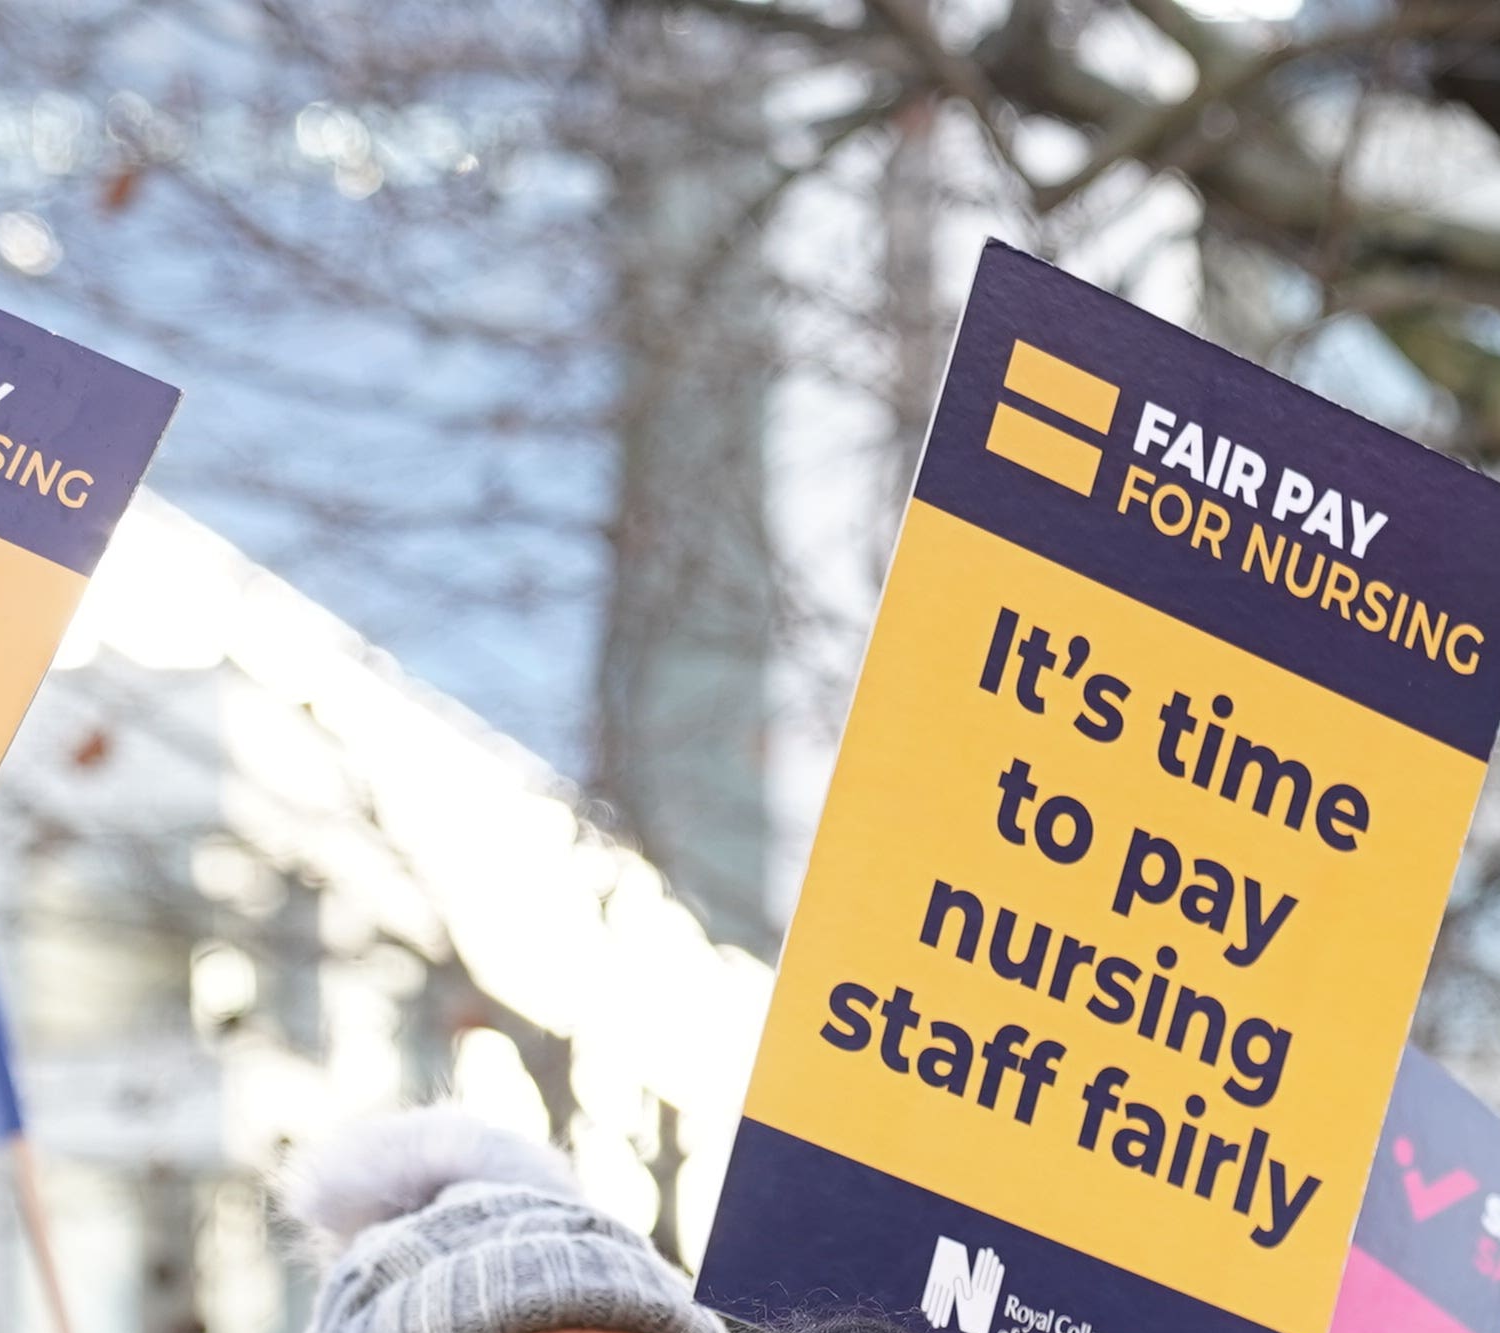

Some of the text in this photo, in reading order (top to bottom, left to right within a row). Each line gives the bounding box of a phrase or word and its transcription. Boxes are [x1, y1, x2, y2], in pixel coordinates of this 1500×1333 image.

[1117, 464, 1486, 677] FOR NURSING
[1133, 400, 1389, 560] FAIR PAY
[997, 758, 1299, 968] to pay
[1157, 693, 1371, 850] time
[918, 879, 1293, 1108] nursing
[819, 979, 1324, 1250] staff fairly
[1004, 1294, 1055, 1333] Royal
